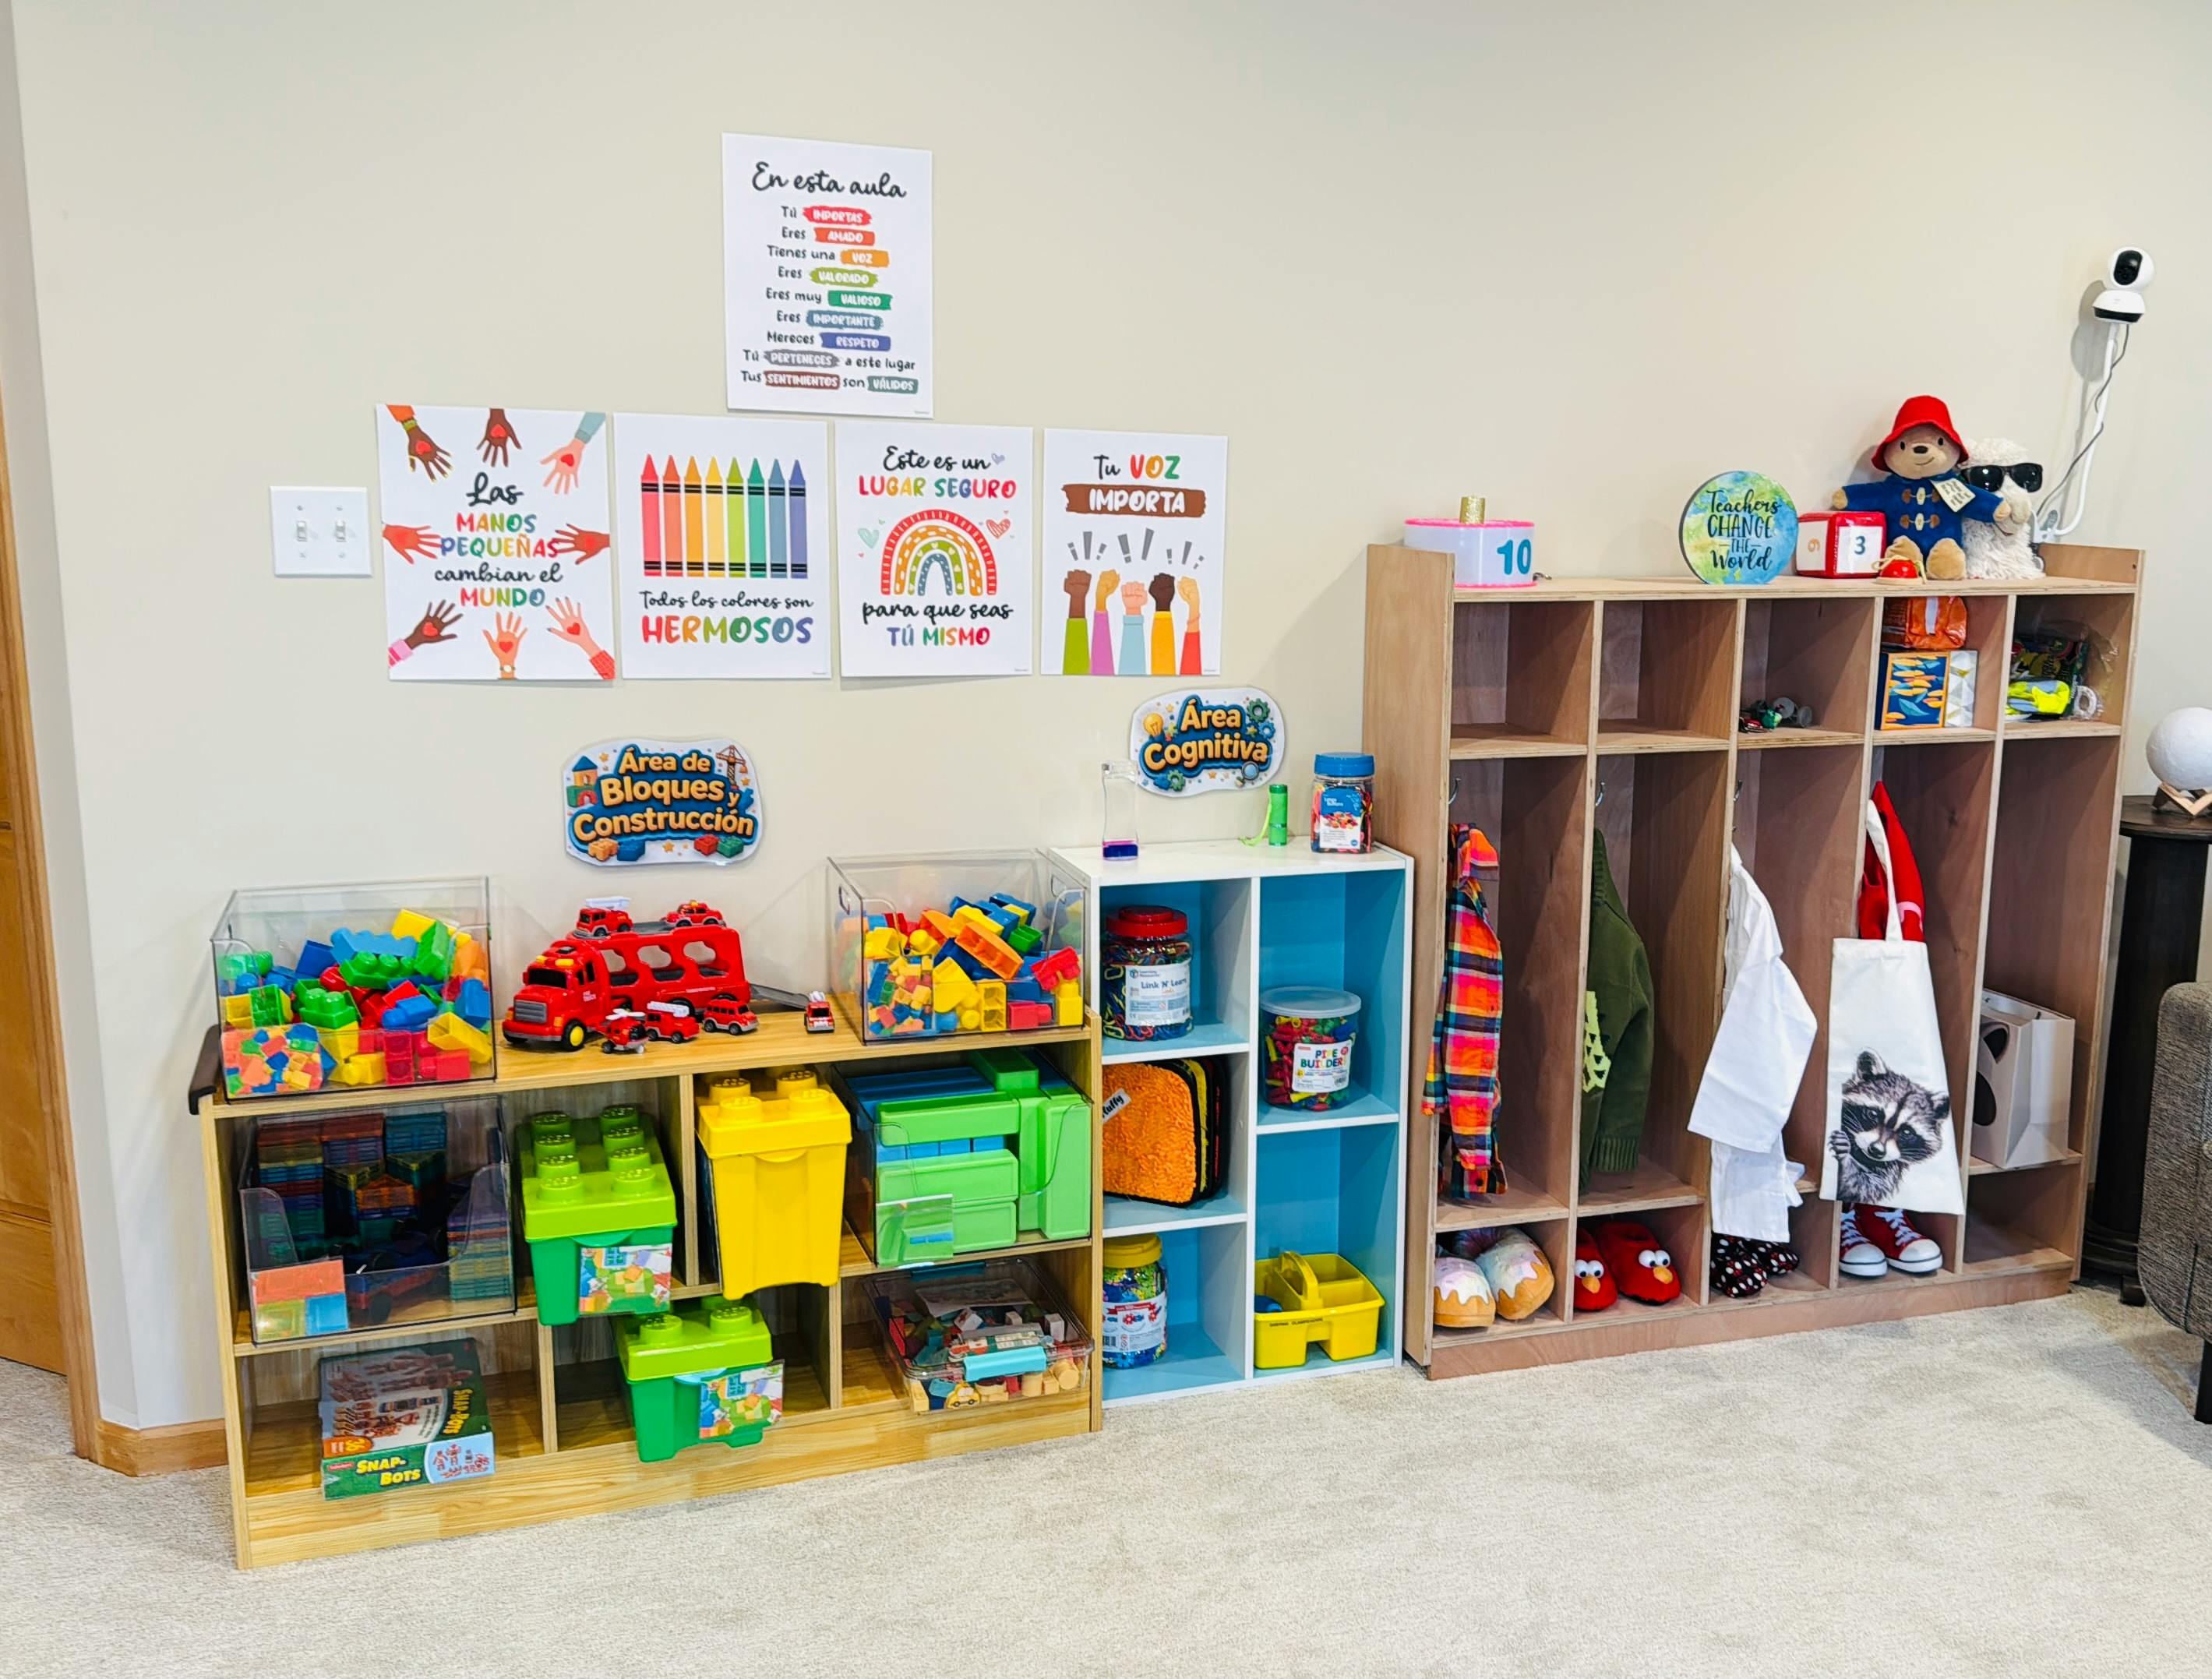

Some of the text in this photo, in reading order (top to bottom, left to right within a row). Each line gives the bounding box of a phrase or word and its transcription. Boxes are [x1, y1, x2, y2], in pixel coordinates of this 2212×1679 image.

[752, 161, 906, 198] En esta aula
[781, 206, 863, 224] Tú IMPORTAS
[781, 227, 863, 243] Eres AMADO
[767, 245, 873, 263] Tienes una VOZ
[778, 266, 870, 285] Eres VALORADO
[766, 288, 881, 307] Eres muy VALIOSO
[777, 310, 875, 328] Eres IMPORTANTE
[767, 332, 879, 349] Mereces RESPETO
[743, 350, 759, 362] Tú
[771, 353, 833, 366] PERTENECES
[856, 357, 881, 368] este
[886, 357, 915, 372] lugar
[741, 371, 915, 391] Tus SENTIMIENTOS son VÁLIDOS
[884, 446, 991, 471] Este es un
[1093, 453, 1180, 480] Tu VOZ
[466, 471, 524, 506] Las
[859, 475, 1017, 499] LUGAR SEGURO
[1089, 489, 1185, 513] IMPORTA
[1706, 489, 1783, 514] Teachers
[457, 513, 537, 533] MANOS
[1707, 514, 1773, 538] CHANGE
[440, 534, 559, 558] PEQUEÑAS
[1731, 538, 1750, 553] THE
[1854, 535, 1866, 555] 3
[1497, 539, 1532, 575] 10
[1710, 546, 1773, 571] World
[435, 562, 563, 582] cambian el
[460, 587, 545, 607] MUNDO
[639, 590, 813, 609] Todos los colores son
[863, 602, 1014, 625] para que seas
[642, 616, 813, 644] HERMOSOS
[887, 623, 990, 647] TÚ MISMO
[1180, 699, 1241, 732] Área
[619, 747, 711, 774] Área de
[1144, 732, 1268, 771] Cognitiva
[600, 776, 739, 807] Bloques y
[573, 807, 753, 841] Construcción
[356, 1456, 406, 1473] SNAP-
[380, 1469, 421, 1486] BOTS
